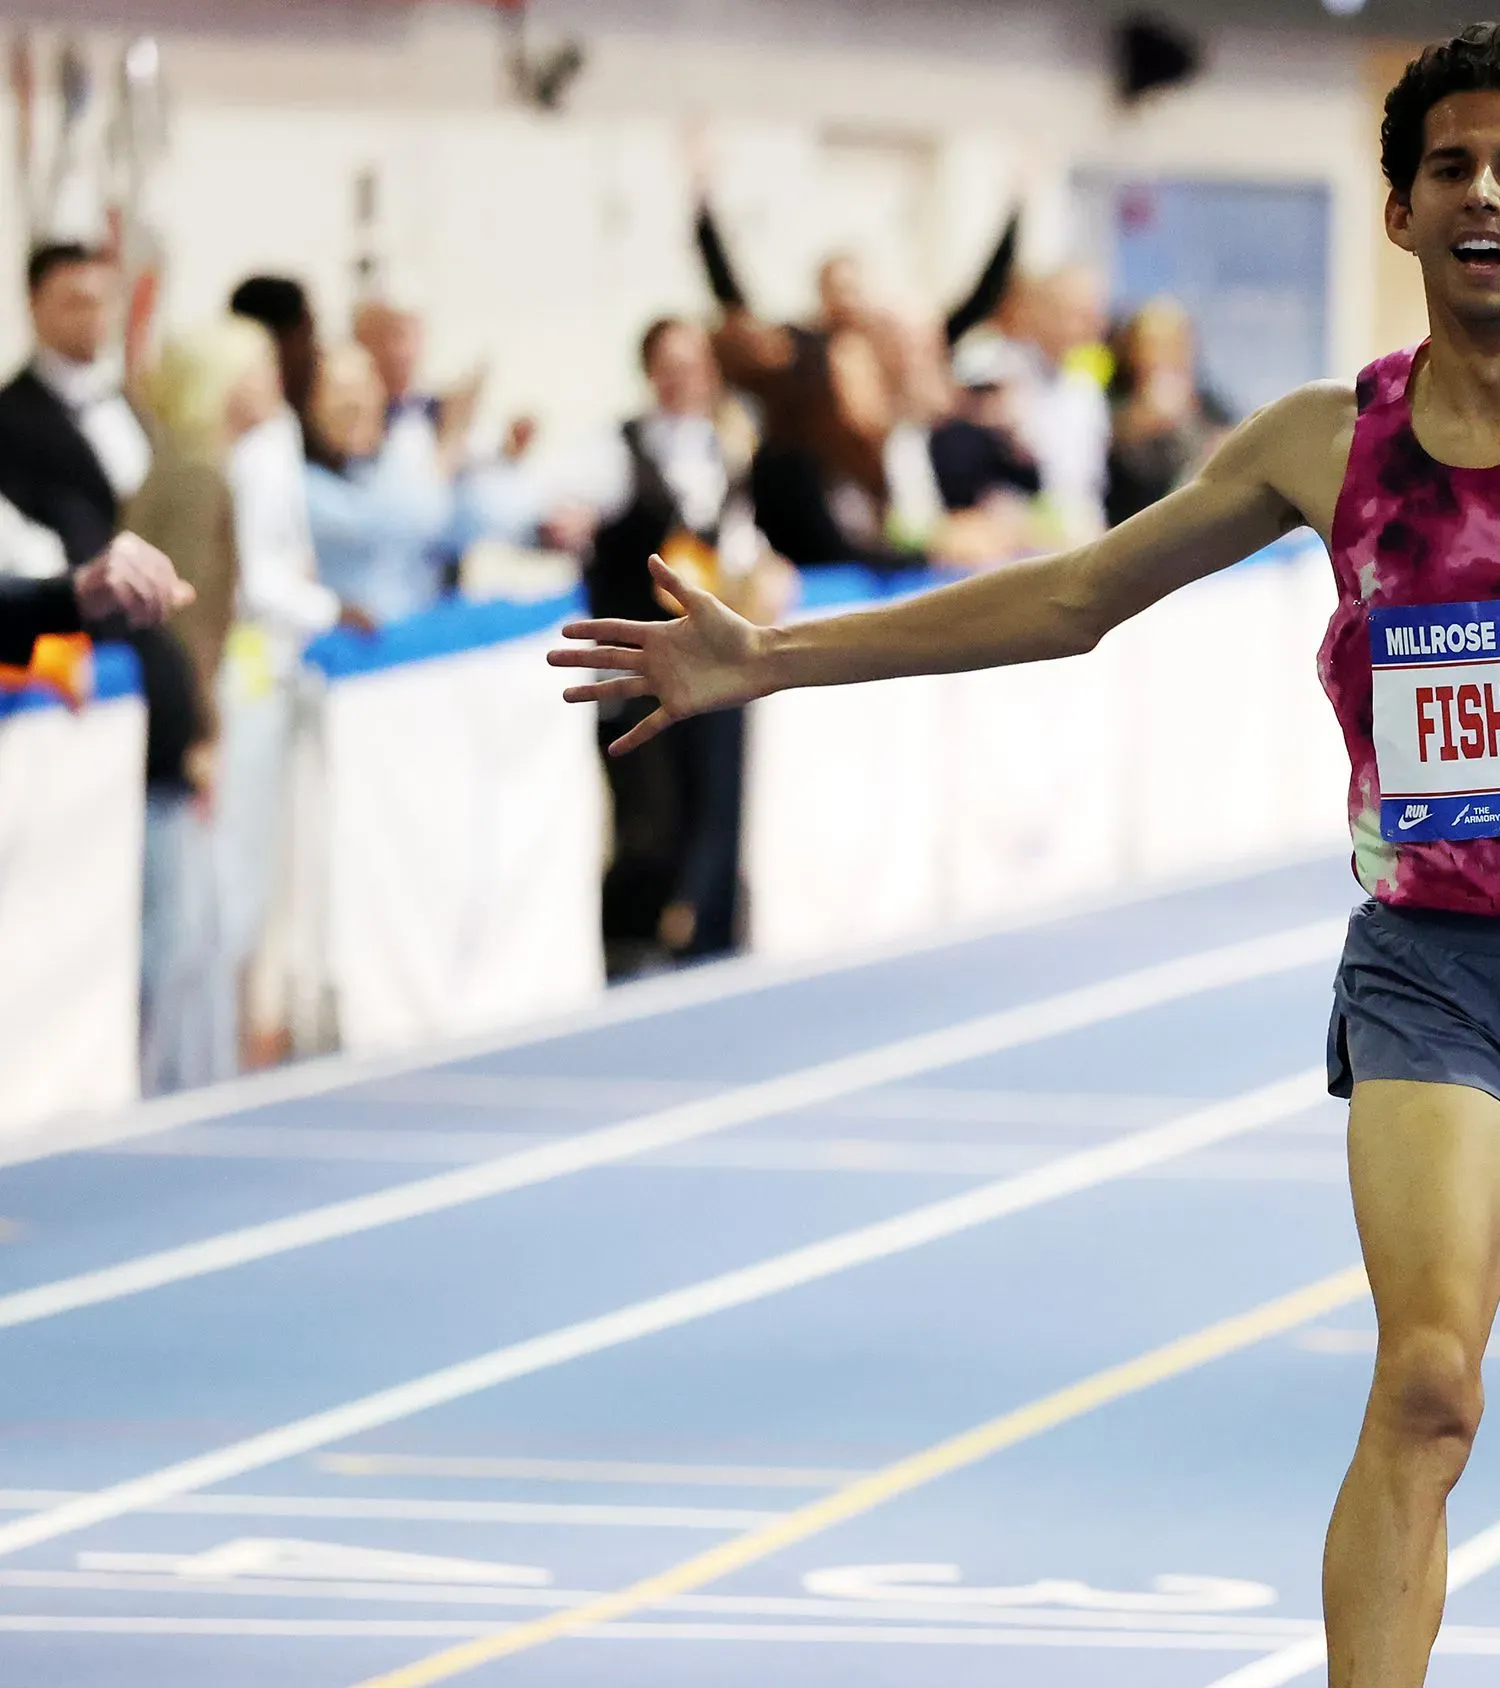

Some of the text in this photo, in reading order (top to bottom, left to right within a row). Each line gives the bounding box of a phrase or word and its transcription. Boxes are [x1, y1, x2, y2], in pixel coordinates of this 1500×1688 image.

[1385, 622, 1497, 656] MILLROSE
[1405, 804, 1429, 819] RUN
[1473, 806, 1490, 816] THE
[1464, 813, 1500, 825] ARMORY
